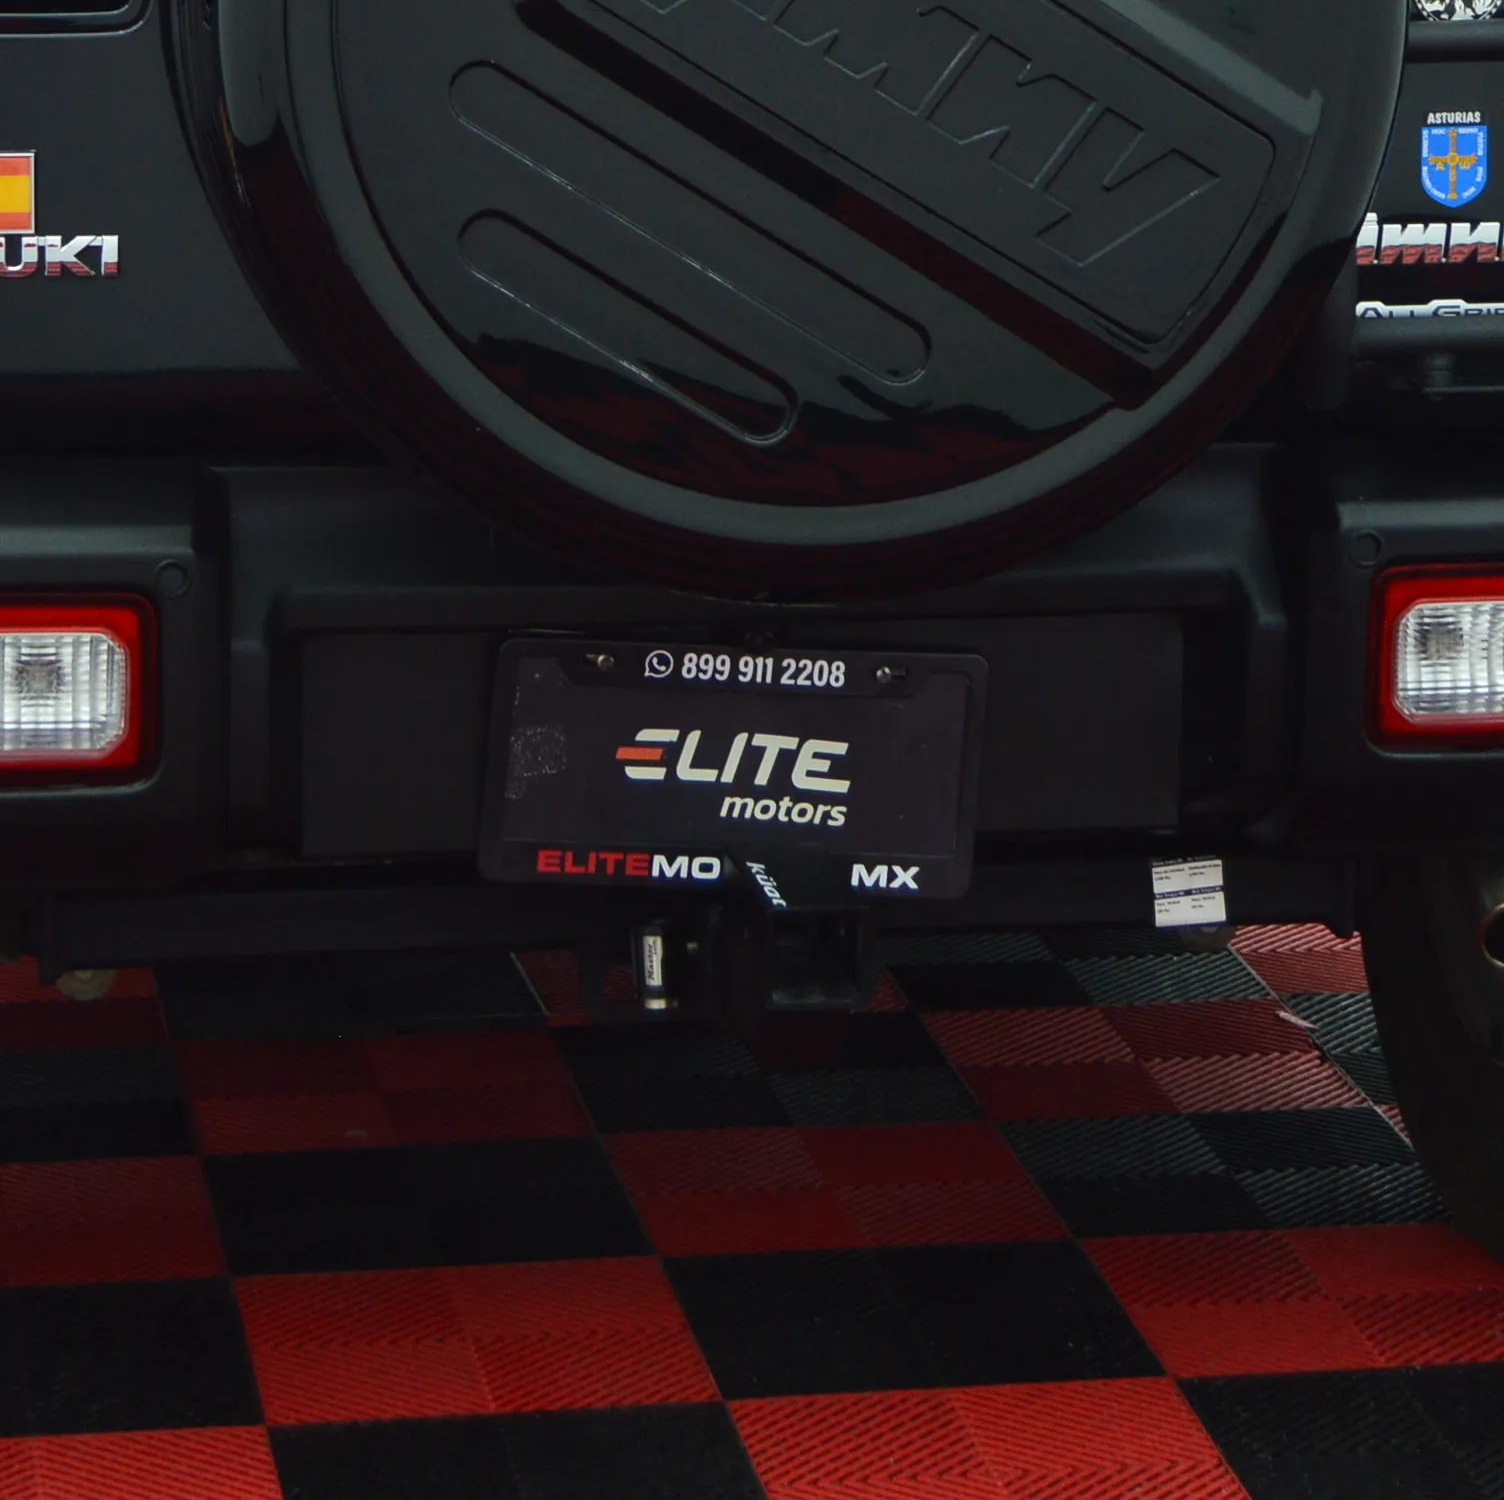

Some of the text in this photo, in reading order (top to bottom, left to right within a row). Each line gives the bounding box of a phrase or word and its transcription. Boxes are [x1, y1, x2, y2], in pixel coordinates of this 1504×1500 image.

[1426, 111, 1482, 125] ASTURIAS
[681, 652, 846, 688] 899 911 2208
[615, 728, 851, 794] ELITE
[719, 795, 848, 827] motors
